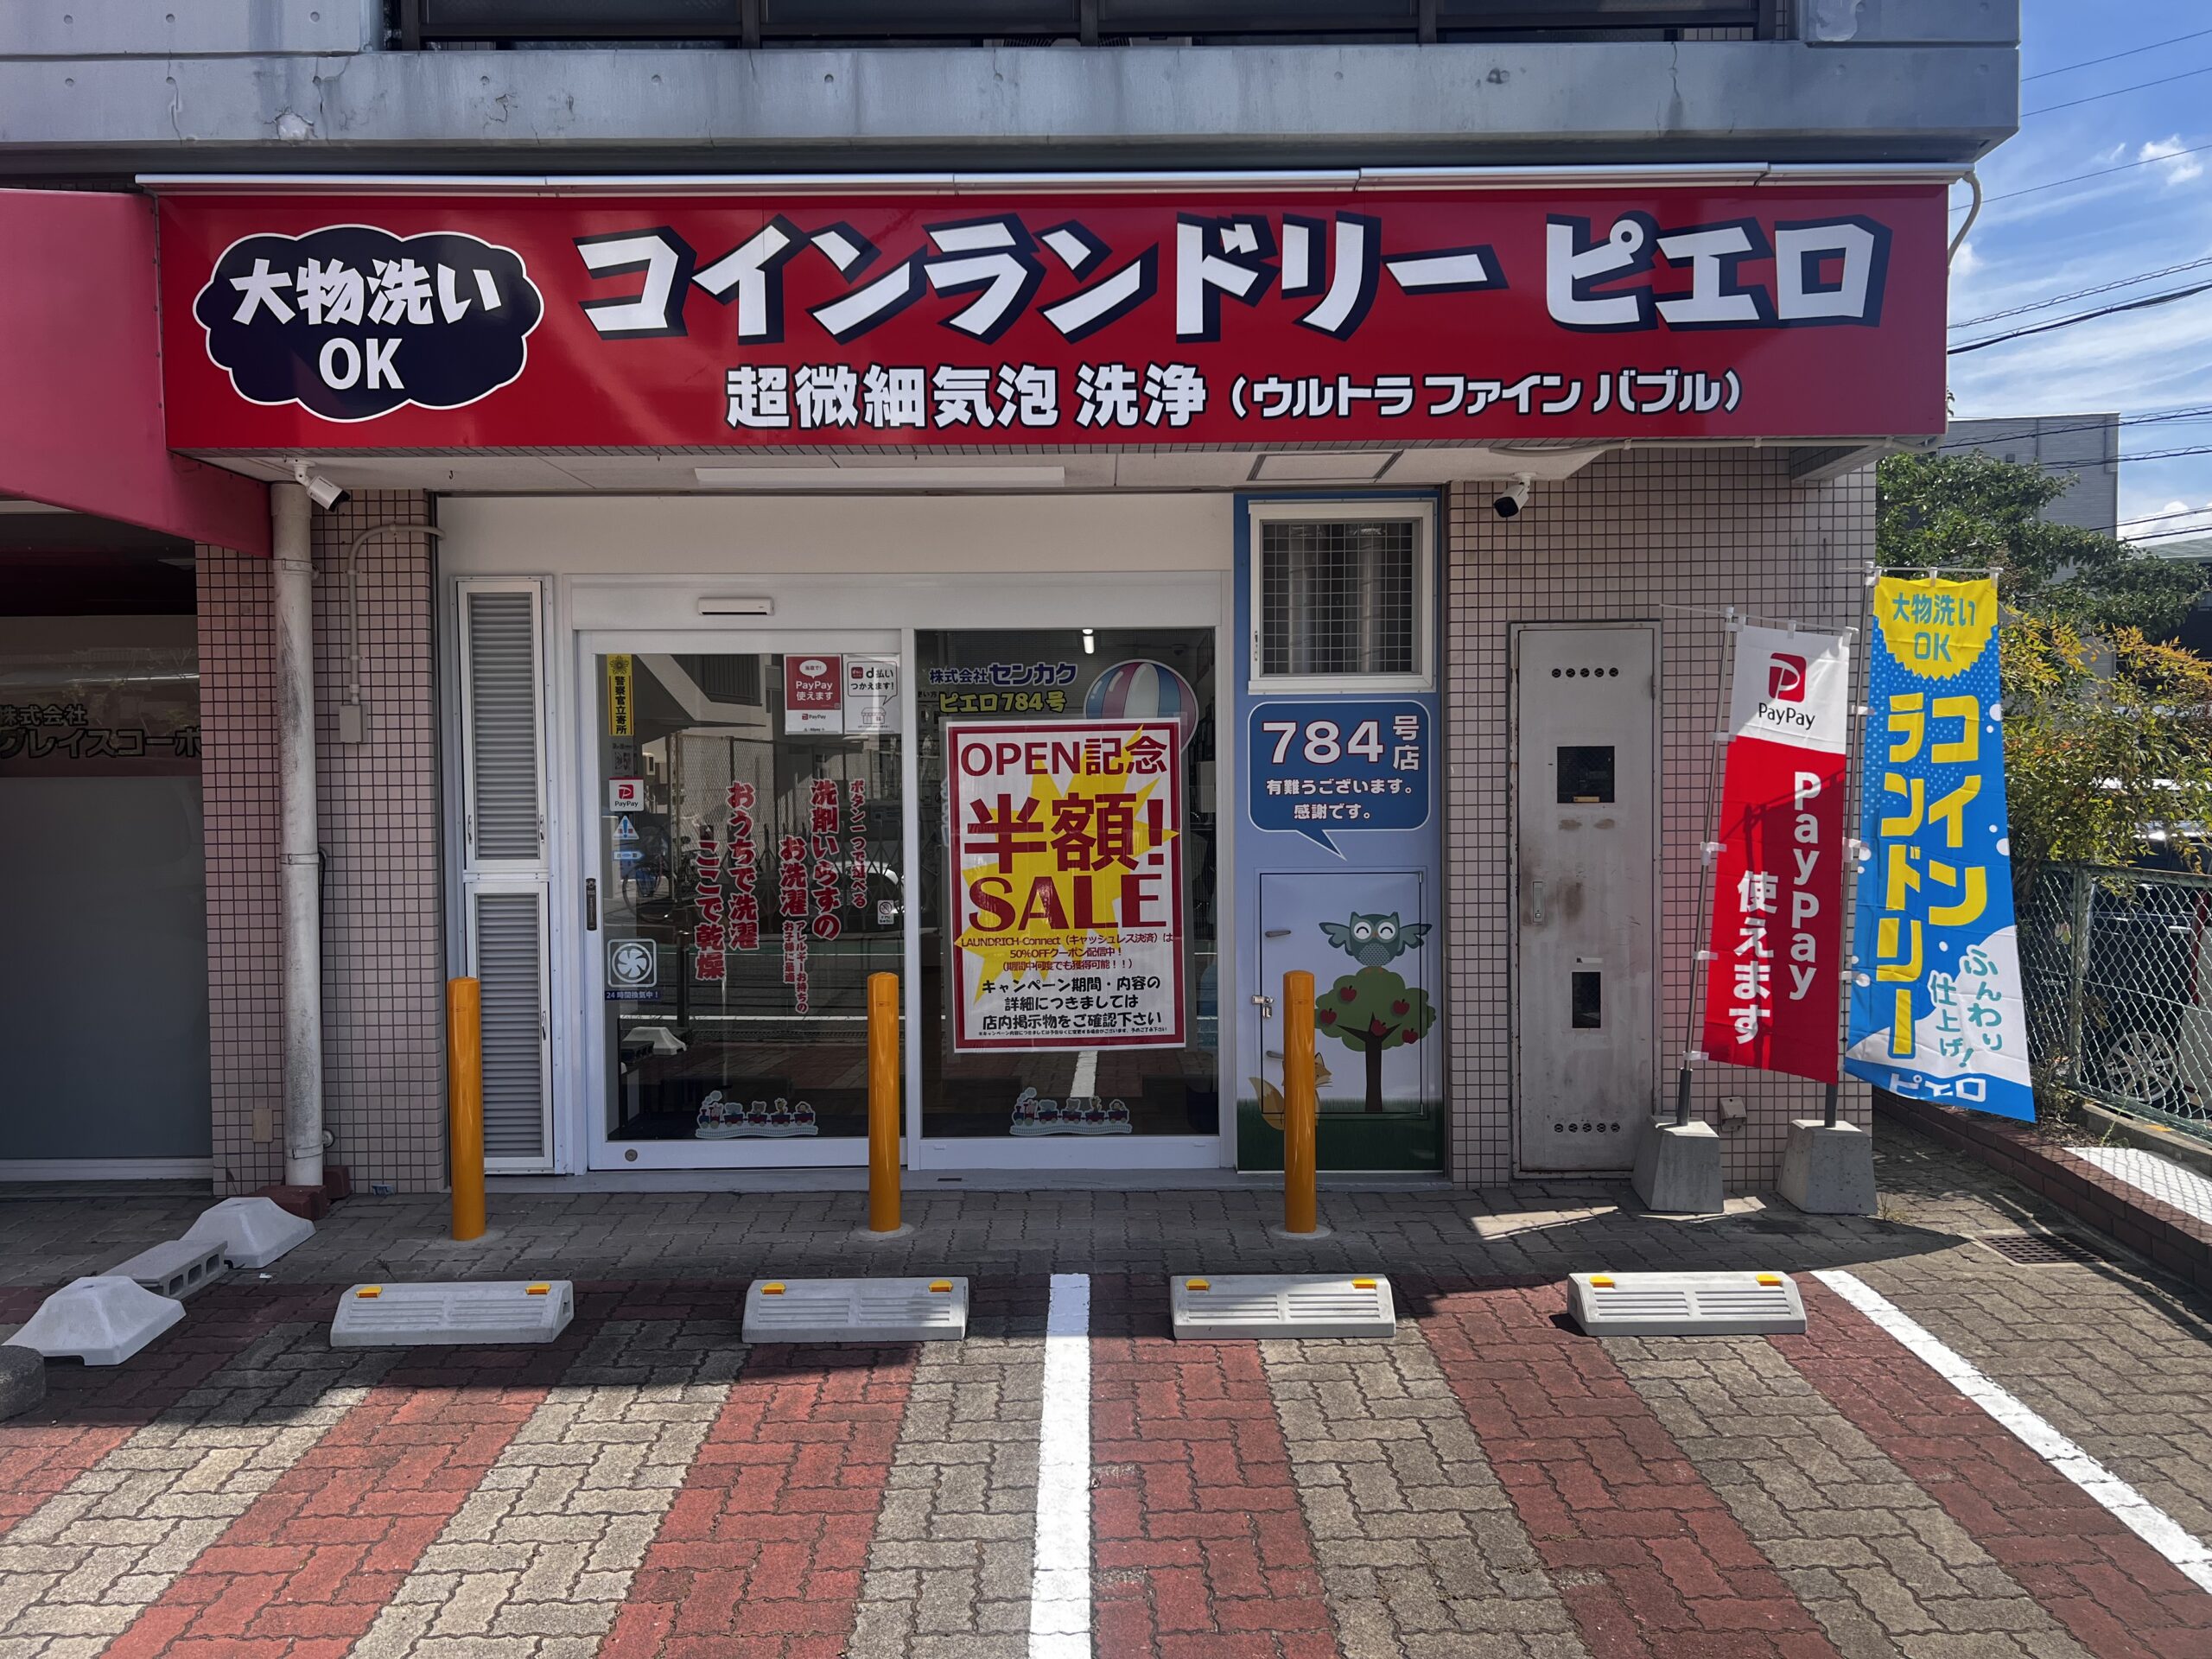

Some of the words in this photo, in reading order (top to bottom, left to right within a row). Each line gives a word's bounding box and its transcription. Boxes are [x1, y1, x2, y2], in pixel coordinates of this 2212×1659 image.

[230, 257, 502, 326] 大物洗い
[574, 213, 1508, 343] コインランドリー
[1546, 211, 1892, 332] ピエロ
[318, 337, 406, 391] OK
[1892, 592, 1976, 626] 大物洗い
[1914, 632, 1952, 662] OK
[614, 676, 627, 734] 警察官立寄所
[796, 681, 833, 690] PayPay
[797, 691, 833, 701] 使えます
[851, 682, 893, 690] つかえます!
[0, 704, 88, 727] 株式会社
[1759, 702, 1815, 730] PayPay
[961, 735, 1169, 777] OPEN記念
[1262, 720, 1384, 765] 784
[1392, 715, 1420, 771] 号店
[1266, 778, 1413, 796] 有難うございます。
[964, 792, 1165, 874] 半額!
[1294, 804, 1371, 820] 感謝です。
[727, 780, 760, 950] おうちで洗濯
[779, 836, 808, 917] お洗濯
[810, 779, 841, 940] 洗剤いらずの
[968, 873, 1167, 932] SALE
[1788, 771, 1821, 1001] PayPay
[695, 840, 725, 981] ここで乾燥
[1727, 869, 1778, 1046] 使えます
[982, 976, 1161, 994] キャンペーン期間・内容の
[1004, 995, 1139, 1011] 詳細につきましては
[1964, 949, 2002, 1051] ふんわり
[982, 1012, 1162, 1030] 店内掲示物をご確認下さい
[1889, 1073, 1986, 1103] ピエロ
